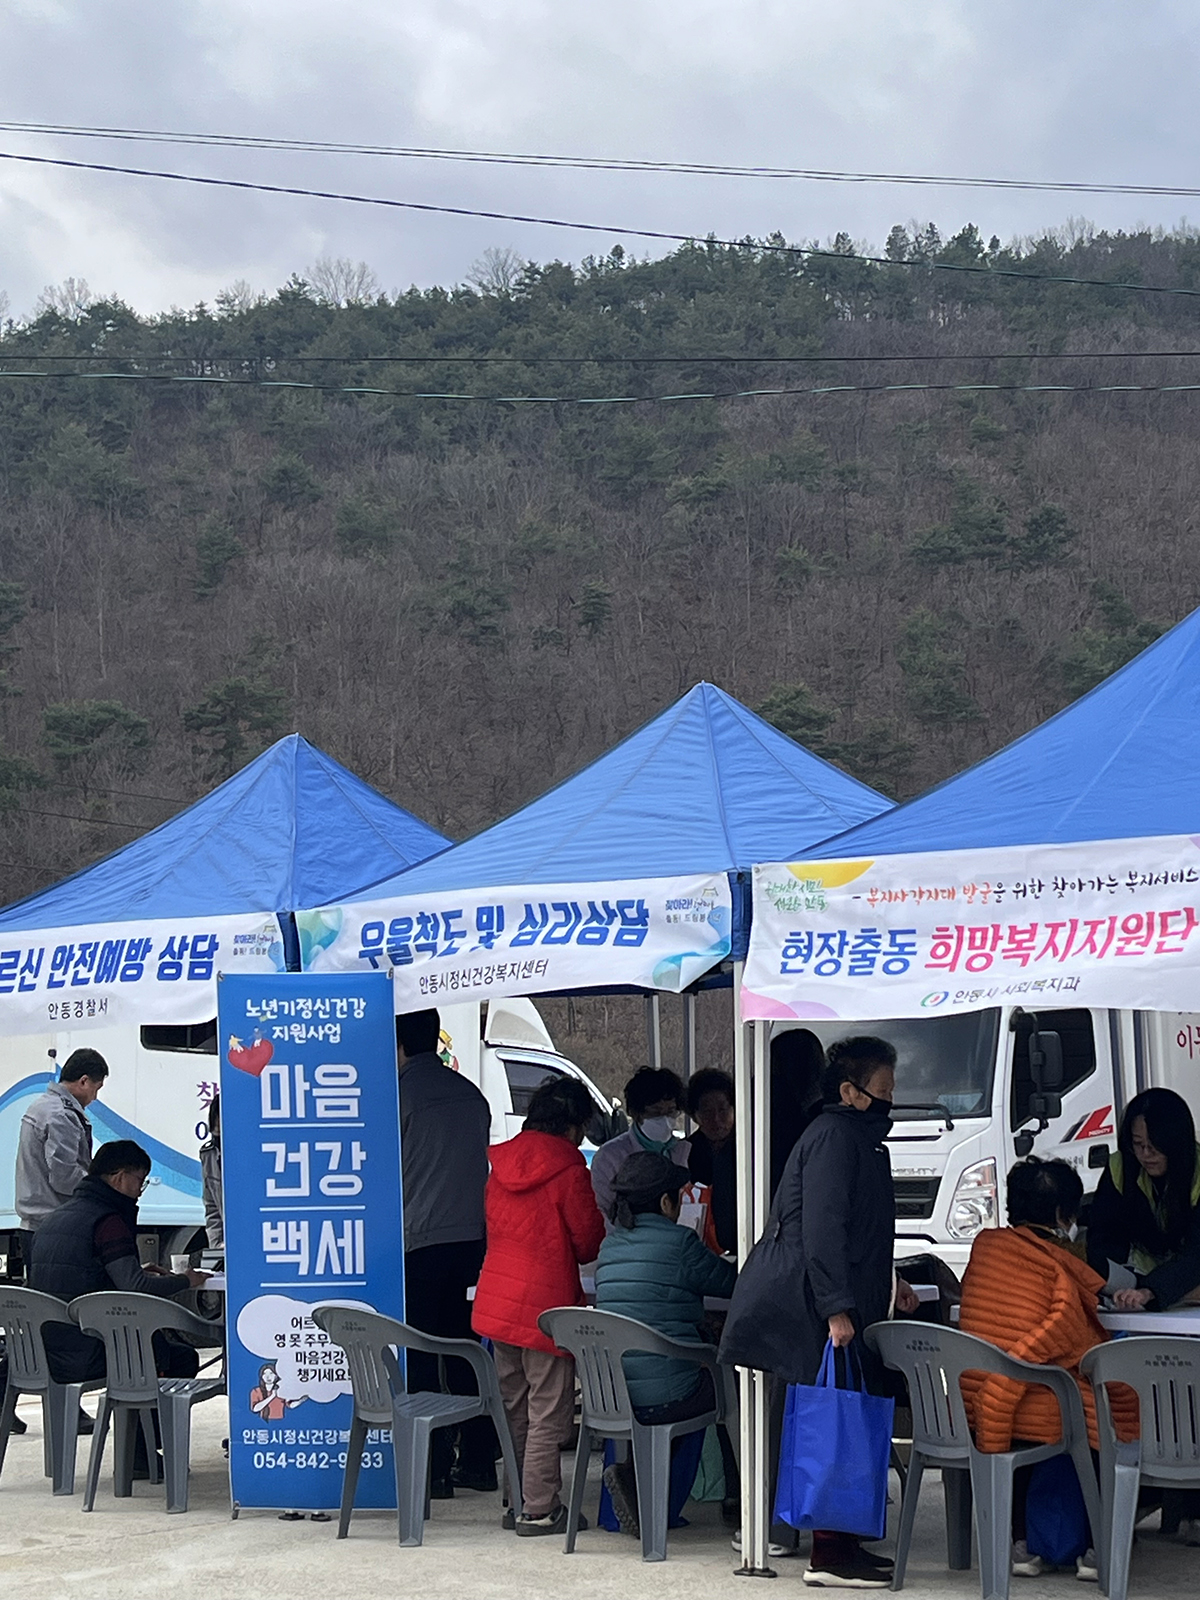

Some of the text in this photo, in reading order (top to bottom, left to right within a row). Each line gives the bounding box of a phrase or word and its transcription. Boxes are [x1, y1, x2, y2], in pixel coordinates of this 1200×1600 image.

[867, 867, 1200, 908] 복지사각지대 발굴을 위한 찾아가는 복지서비스
[358, 899, 650, 969] 우울척도 및 심리상담
[780, 907, 1199, 976] 현장출동 희망복지지원단
[0, 934, 219, 993] 르신 안전예방 상담
[419, 958, 549, 995] 안동시정신건강복지센터
[953, 976, 1081, 1004] 안동시 사회복지과
[48, 998, 108, 1020] 안동경찰서
[246, 998, 366, 1019] 노년기정신건강
[272, 1023, 341, 1043] 지원사업
[260, 1064, 361, 1119] 마음
[261, 1141, 367, 1197] 건강
[262, 1219, 365, 1276] 백세
[291, 1315, 319, 1331] 어르
[275, 1333, 333, 1348] 영 못 주무
[295, 1350, 348, 1366] 마음건강
[242, 1429, 393, 1446] 안동시정신건강복센터
[253, 1451, 384, 1469] 054-842-933
